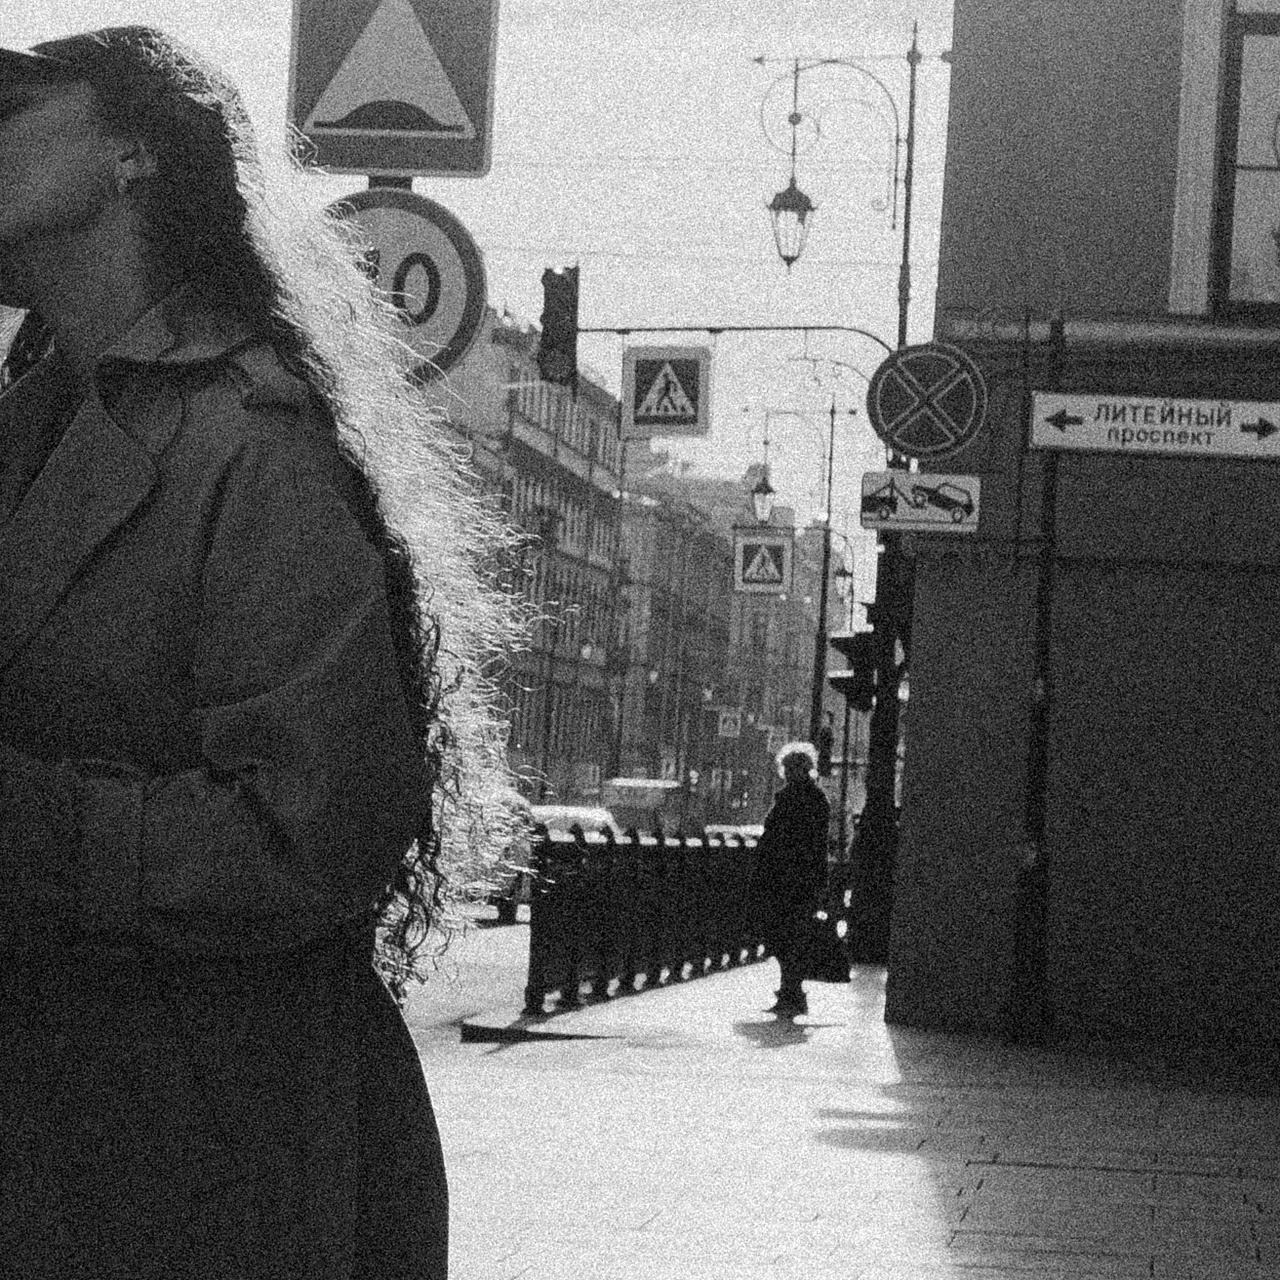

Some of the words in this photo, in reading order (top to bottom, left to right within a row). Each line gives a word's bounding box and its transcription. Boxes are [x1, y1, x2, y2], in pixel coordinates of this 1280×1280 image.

[354, 247, 442, 328] 0
[1093, 401, 1232, 428] ЛИТЕЙНЫЙ
[1107, 426, 1216, 446] проспект
